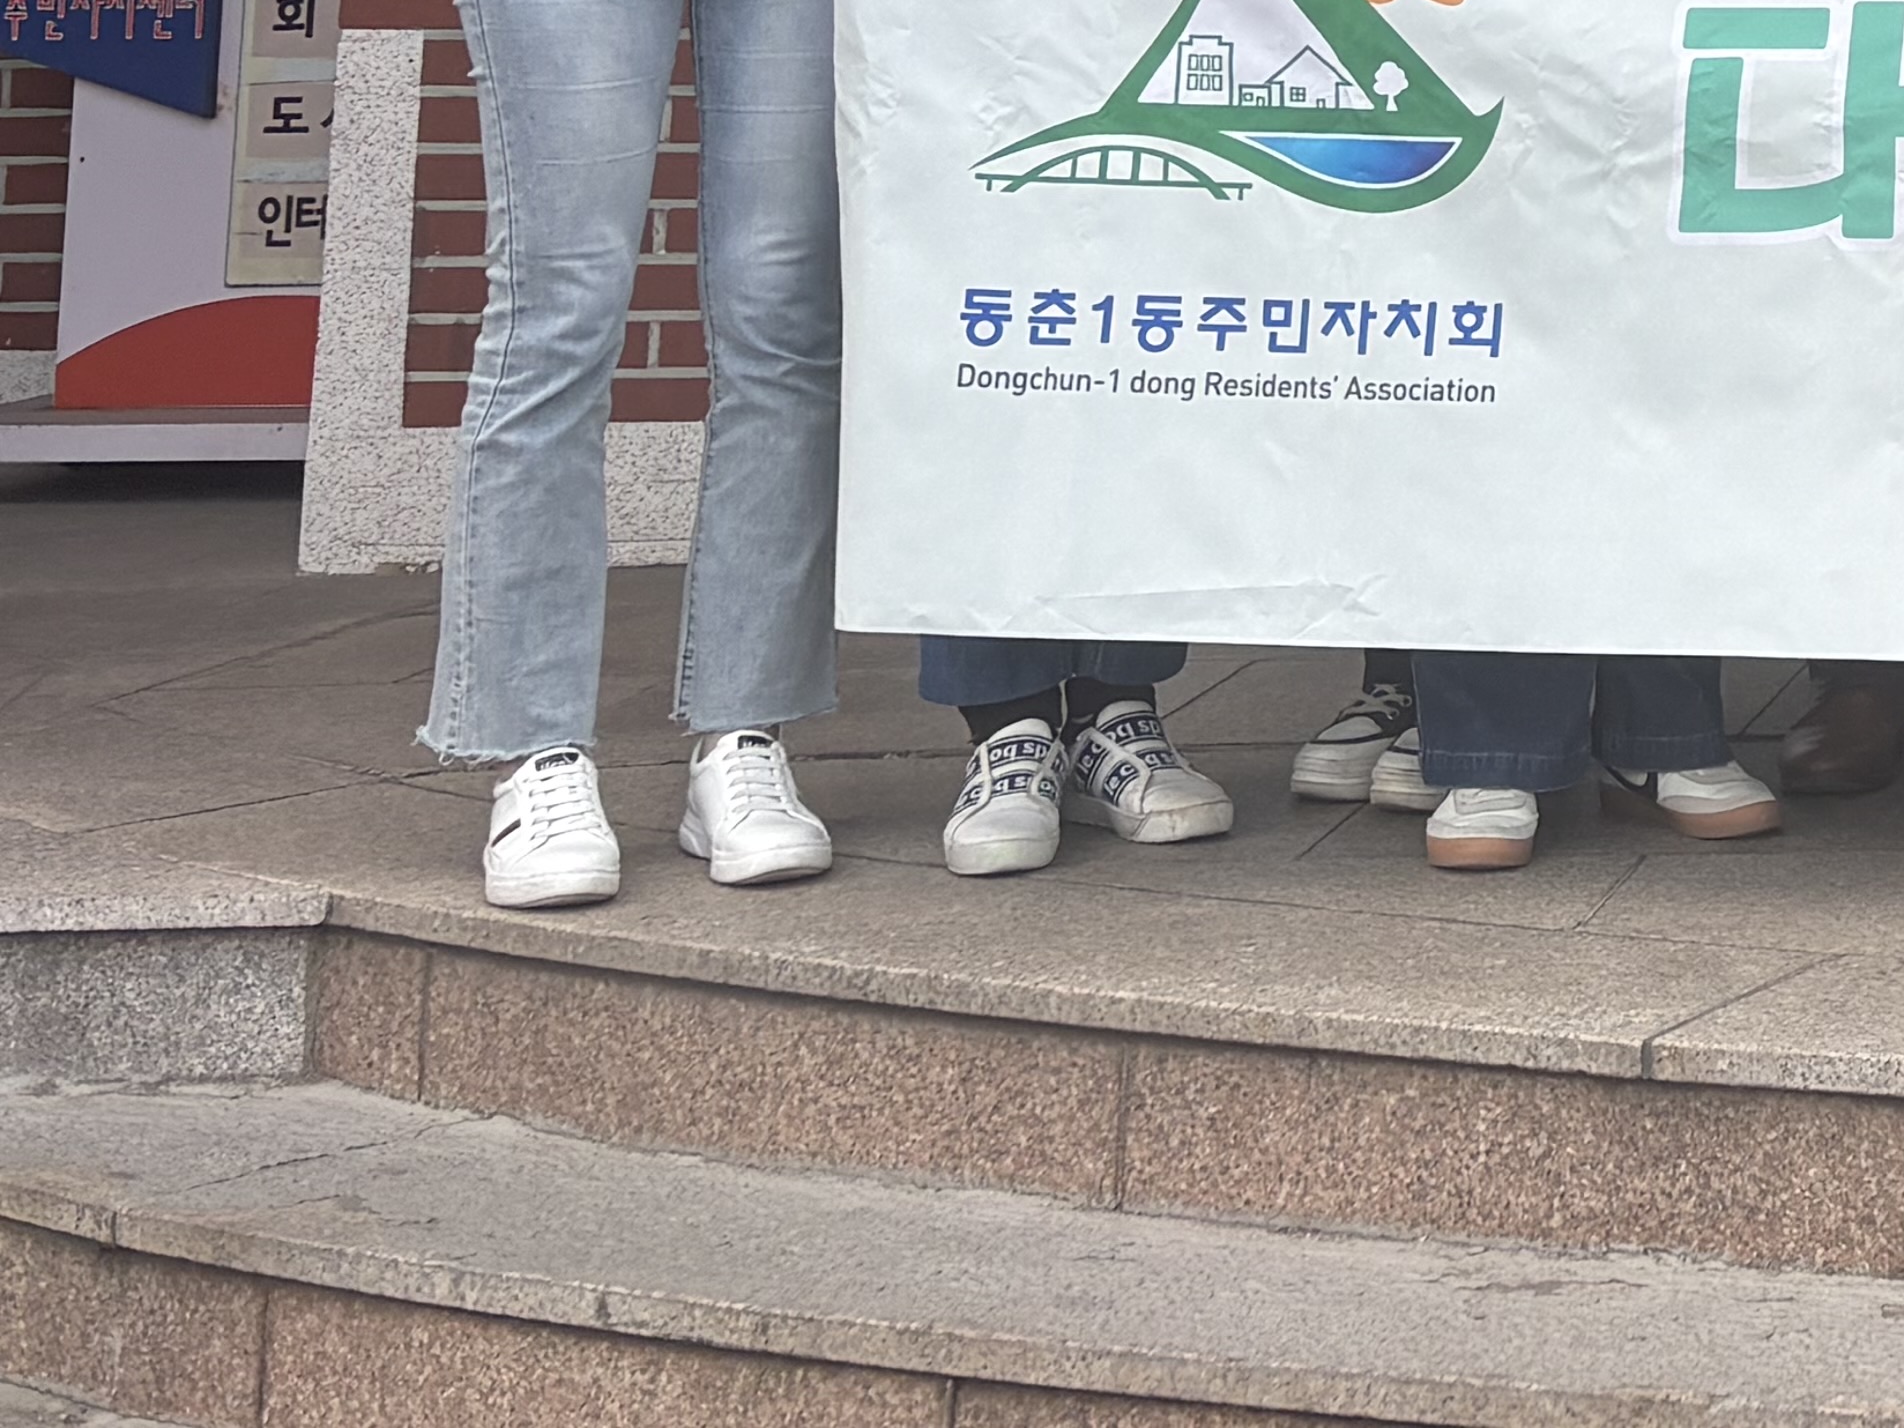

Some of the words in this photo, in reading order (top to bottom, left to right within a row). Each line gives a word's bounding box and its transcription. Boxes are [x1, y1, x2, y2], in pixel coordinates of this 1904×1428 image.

[959, 288, 1504, 357] 동춘1동주민자치회
[957, 362, 1121, 396] Dongchun-1
[1129, 369, 1196, 402] dong
[1344, 375, 1497, 404] Association
